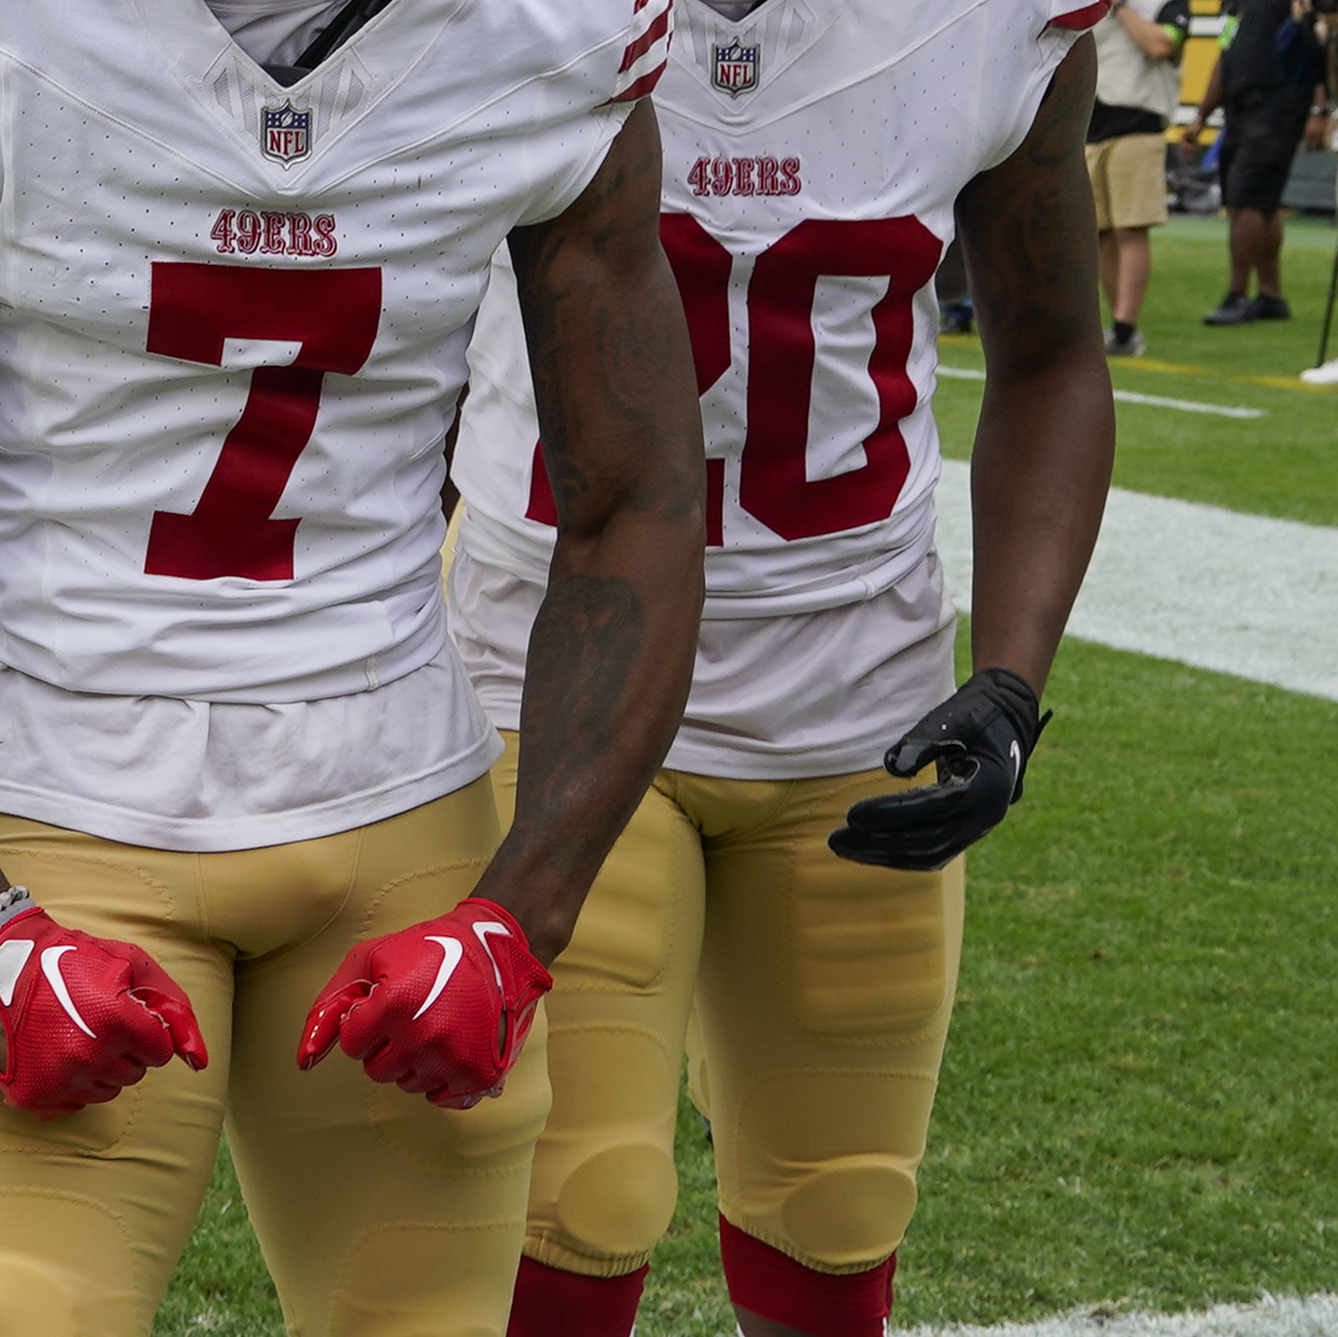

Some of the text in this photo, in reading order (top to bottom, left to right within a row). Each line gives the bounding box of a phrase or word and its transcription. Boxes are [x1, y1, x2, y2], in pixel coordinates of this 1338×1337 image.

[719, 64, 752, 88] NFL
[269, 130, 304, 156] NFL
[687, 154, 802, 197] 49ERS
[211, 209, 337, 258] 49ERS
[144, 262, 383, 581] 7
